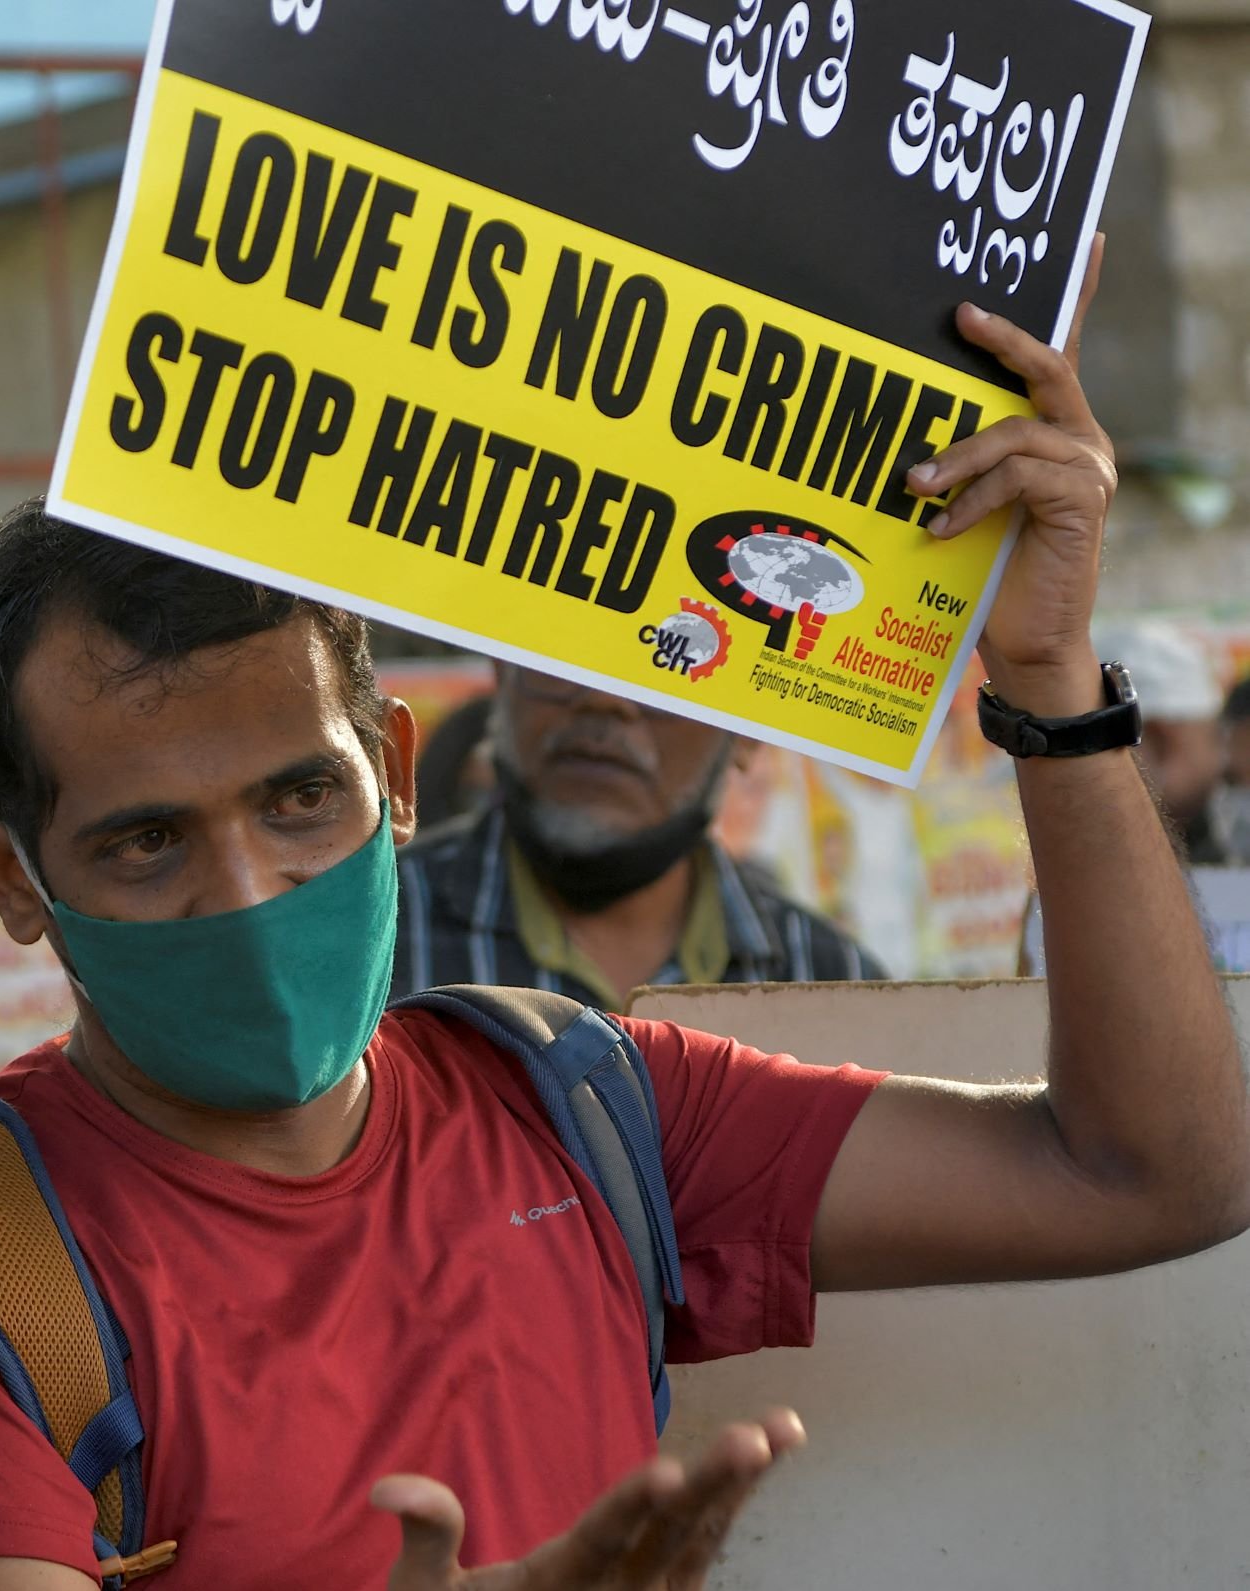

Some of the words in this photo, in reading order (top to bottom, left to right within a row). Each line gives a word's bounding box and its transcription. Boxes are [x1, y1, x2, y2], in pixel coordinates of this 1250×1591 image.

[888, 31, 1085, 295] ತಪ್ಪಲ್ಲ!
[163, 110, 417, 332] LOVE
[411, 203, 527, 369] IS
[524, 246, 668, 420] NO
[109, 311, 355, 505] STOP
[348, 395, 676, 614] HATRED
[917, 579, 968, 617] New
[638, 625, 690, 657] CWI
[652, 649, 697, 676] CIT
[875, 606, 953, 660] Socialist
[832, 635, 935, 697] Alternative
[749, 664, 793, 699] Fighting
[791, 677, 810, 699] for
[807, 683, 867, 719] Democratic
[866, 702, 918, 736] Socialism
